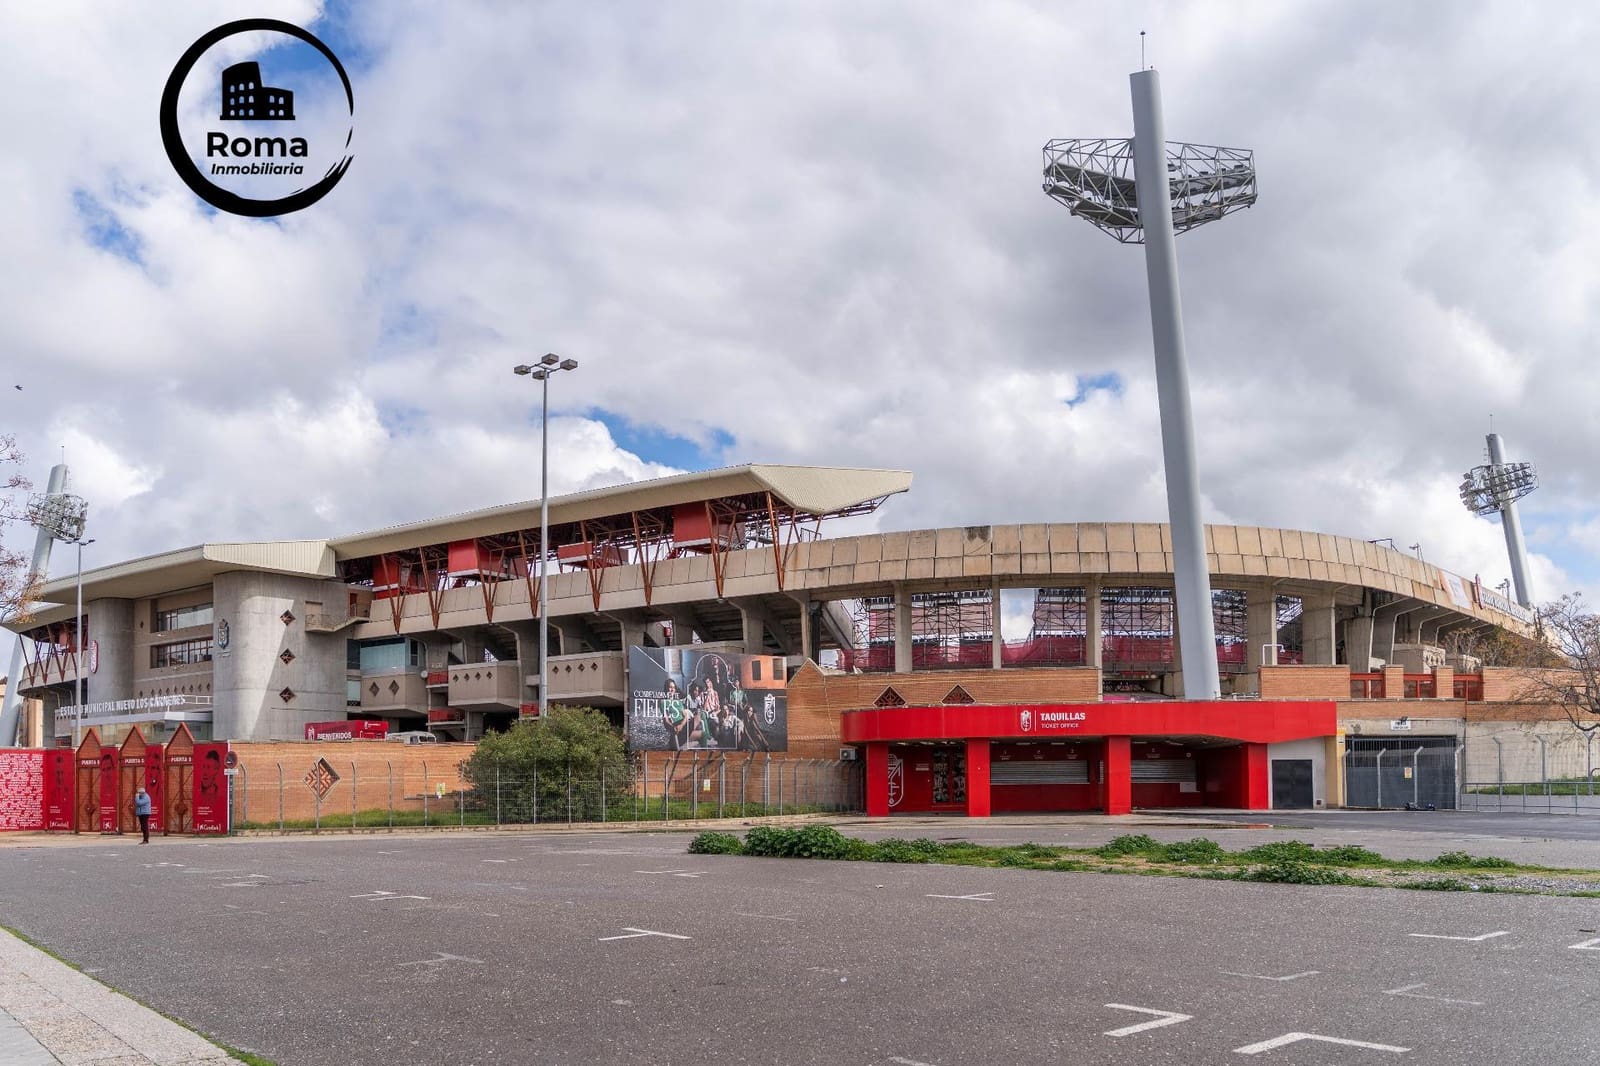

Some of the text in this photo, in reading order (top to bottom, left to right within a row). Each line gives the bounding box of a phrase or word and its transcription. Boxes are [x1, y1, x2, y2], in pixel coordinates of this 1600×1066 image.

[60, 704, 84, 717] ESTADO
[84, 701, 114, 714] MUNICIPAL
[116, 699, 136, 711] NUEVO
[136, 697, 148, 710] LOS
[634, 698, 680, 719] FIELES
[1040, 712, 1086, 721] TAQUILLAS
